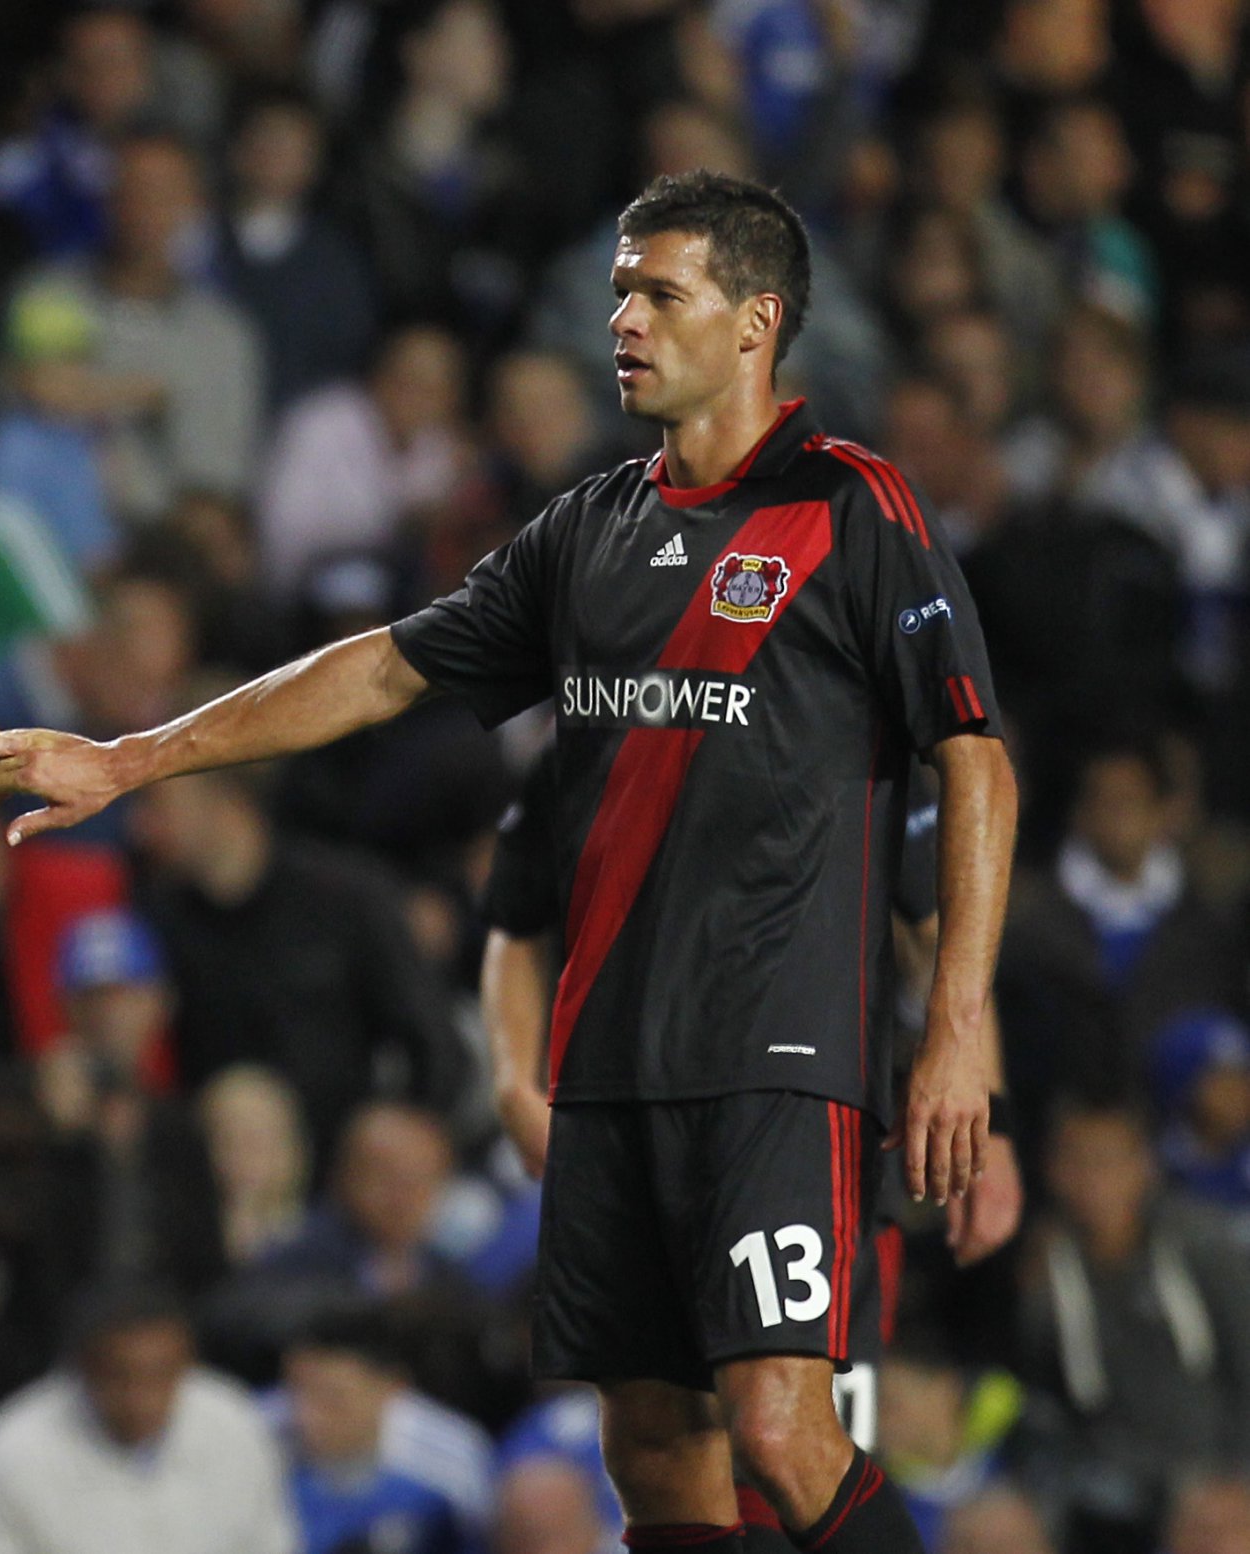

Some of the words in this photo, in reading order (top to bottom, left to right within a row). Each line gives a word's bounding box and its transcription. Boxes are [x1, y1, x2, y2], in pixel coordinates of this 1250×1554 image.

[650, 554, 688, 567] adidas
[563, 676, 751, 726] SUNPOWER
[728, 1223, 832, 1329] 13
